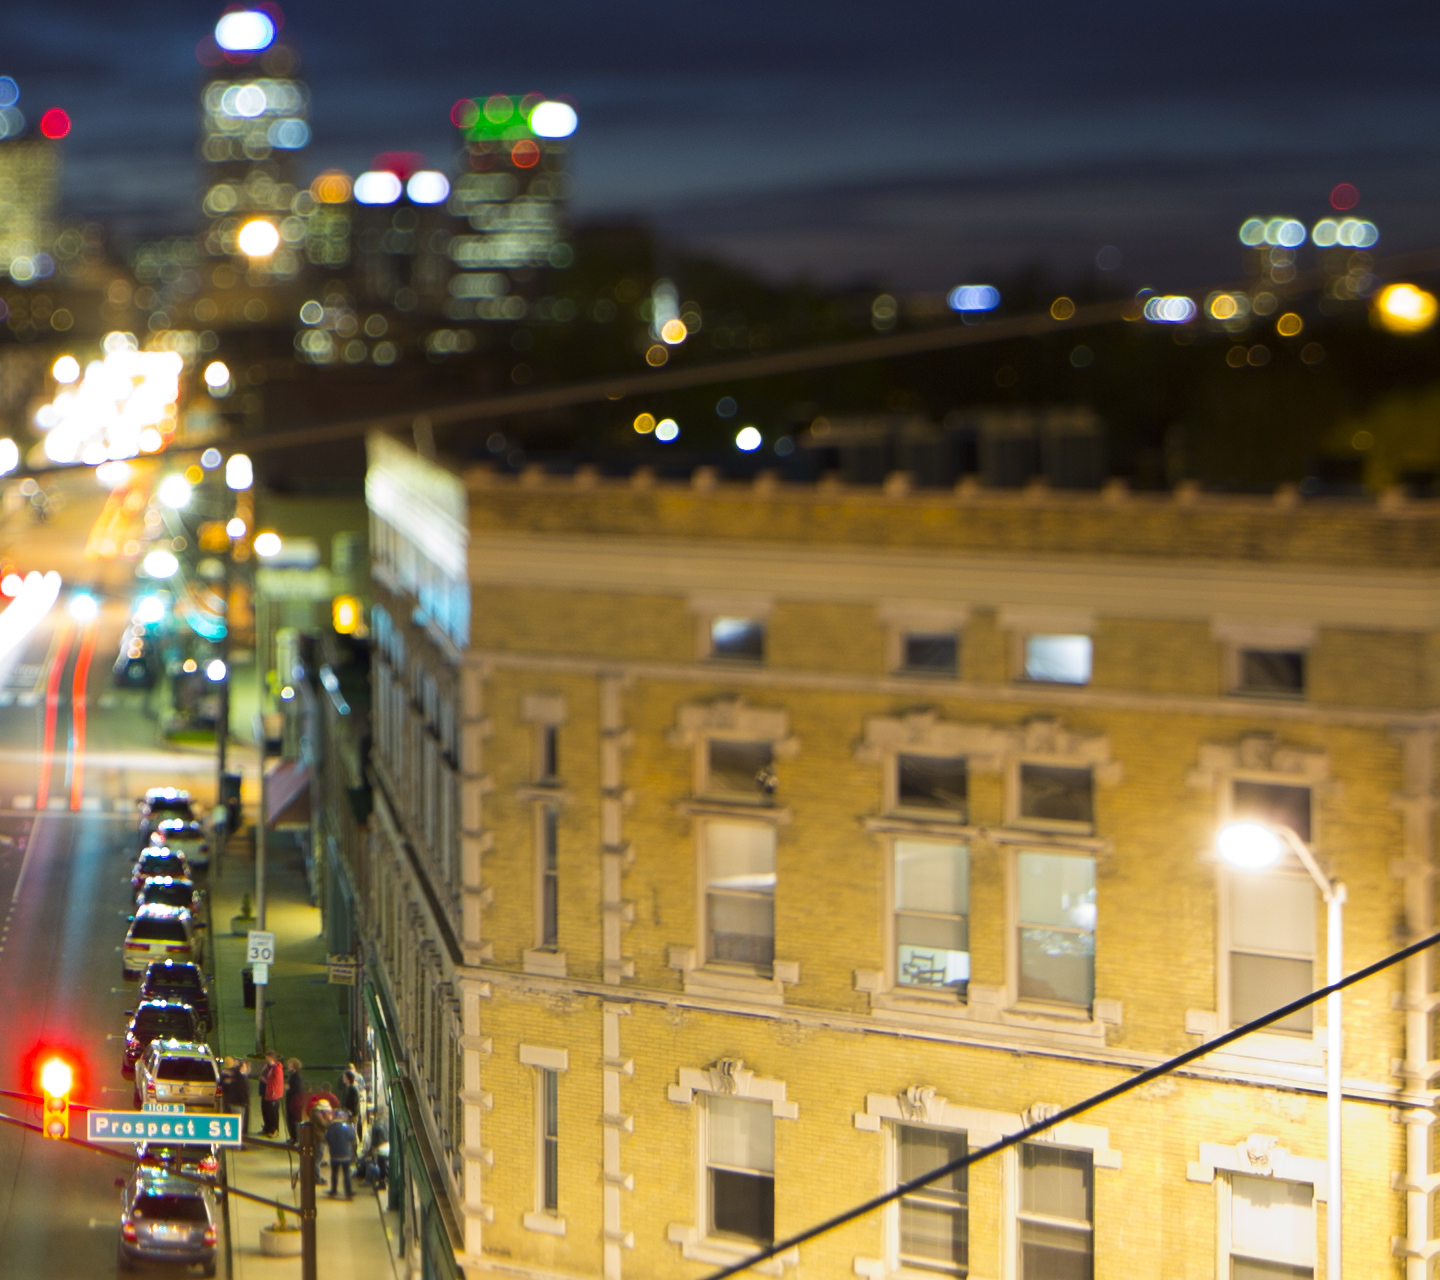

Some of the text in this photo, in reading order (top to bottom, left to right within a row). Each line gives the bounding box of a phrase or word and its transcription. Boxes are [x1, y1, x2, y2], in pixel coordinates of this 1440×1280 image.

[250, 947, 272, 960] 30
[148, 1104, 169, 1112] 1100
[95, 1117, 232, 1137] Prospect St
